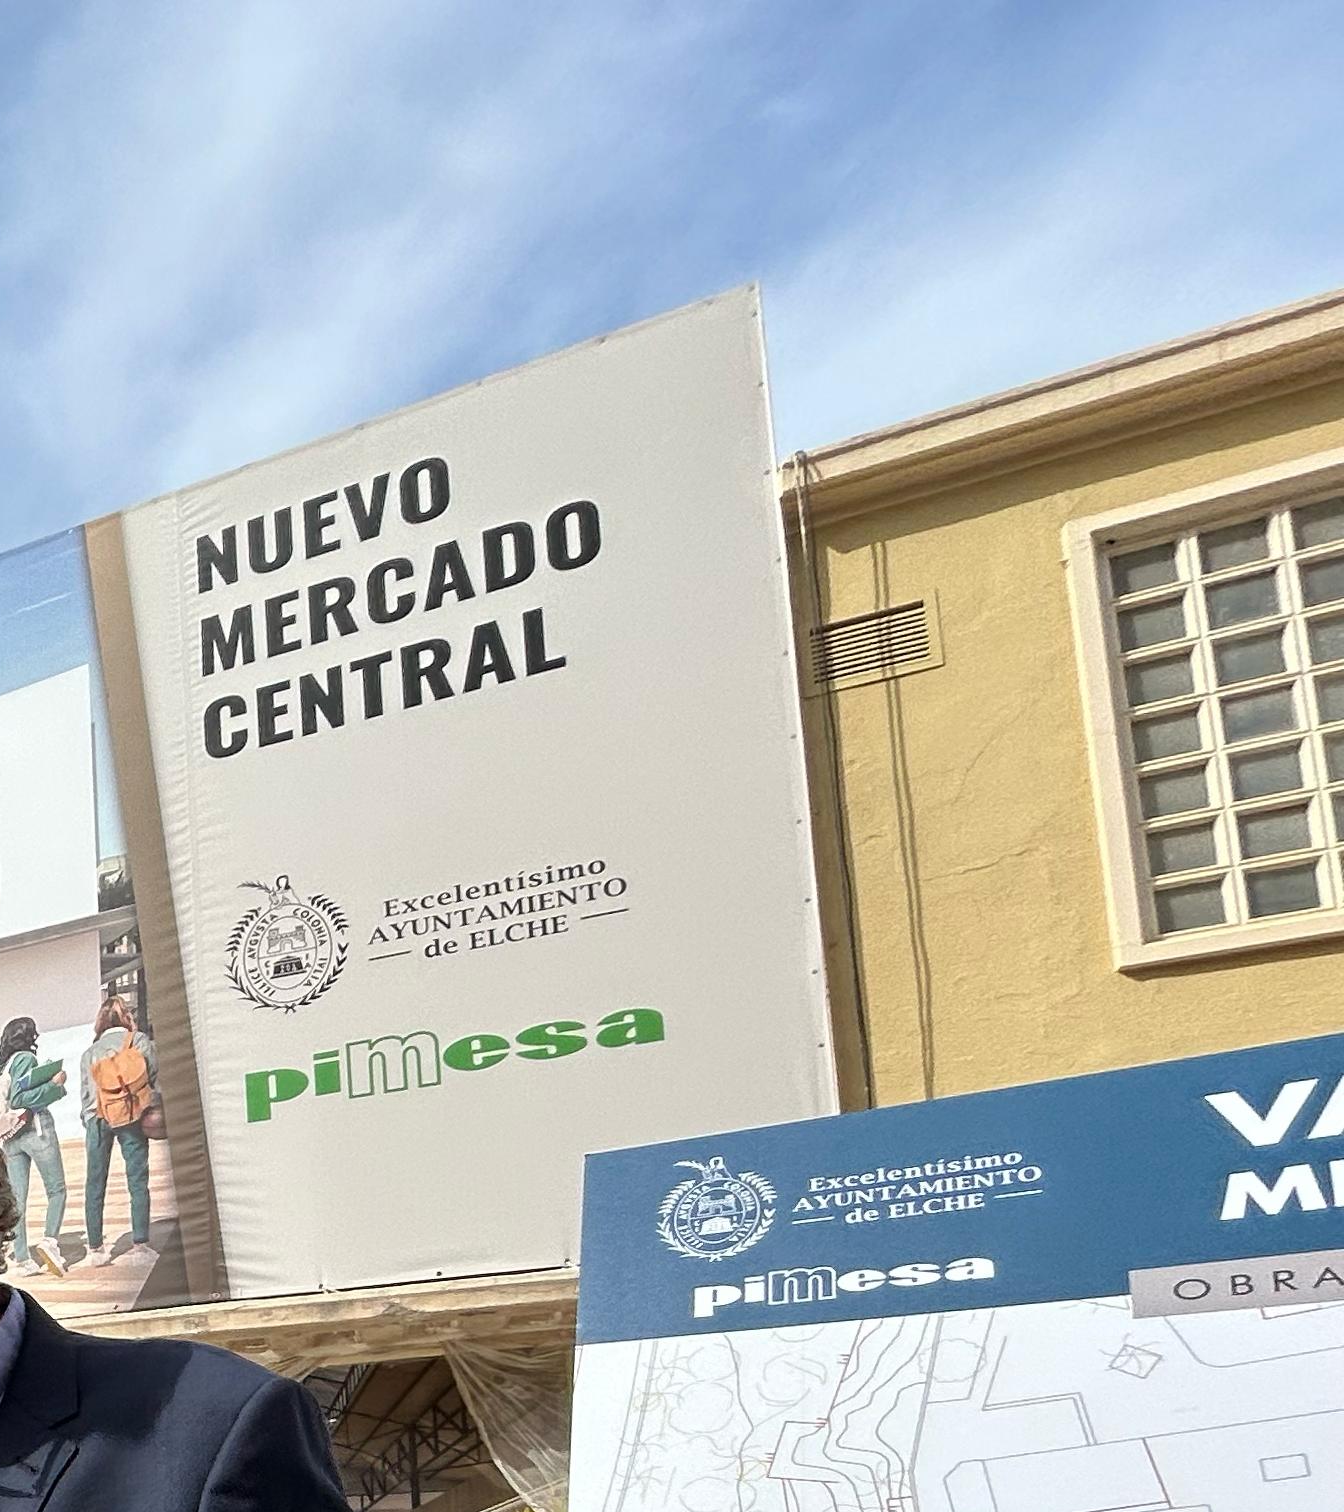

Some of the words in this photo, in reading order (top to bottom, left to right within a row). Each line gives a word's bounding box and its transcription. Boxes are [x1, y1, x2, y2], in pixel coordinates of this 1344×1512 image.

[196, 456, 450, 594] NUEVO
[201, 500, 602, 677] MERCADO
[203, 606, 567, 759] CENTRAL
[368, 877, 627, 945] AYUNTAMIENTO
[383, 859, 606, 917] Excelentísimo
[424, 938, 458, 958] de
[469, 915, 569, 950] ELCHE
[245, 1007, 665, 1124] pimesa
[792, 1166, 1044, 1213] AYUNTAMIENTO
[808, 1151, 1024, 1193] Excelentísimo
[1219, 1158, 1344, 1221] M
[845, 1205, 879, 1224] de
[887, 1192, 986, 1220] ELCHE
[693, 1257, 996, 1318] pimesa
[1173, 1266, 1344, 1300] OBRA
